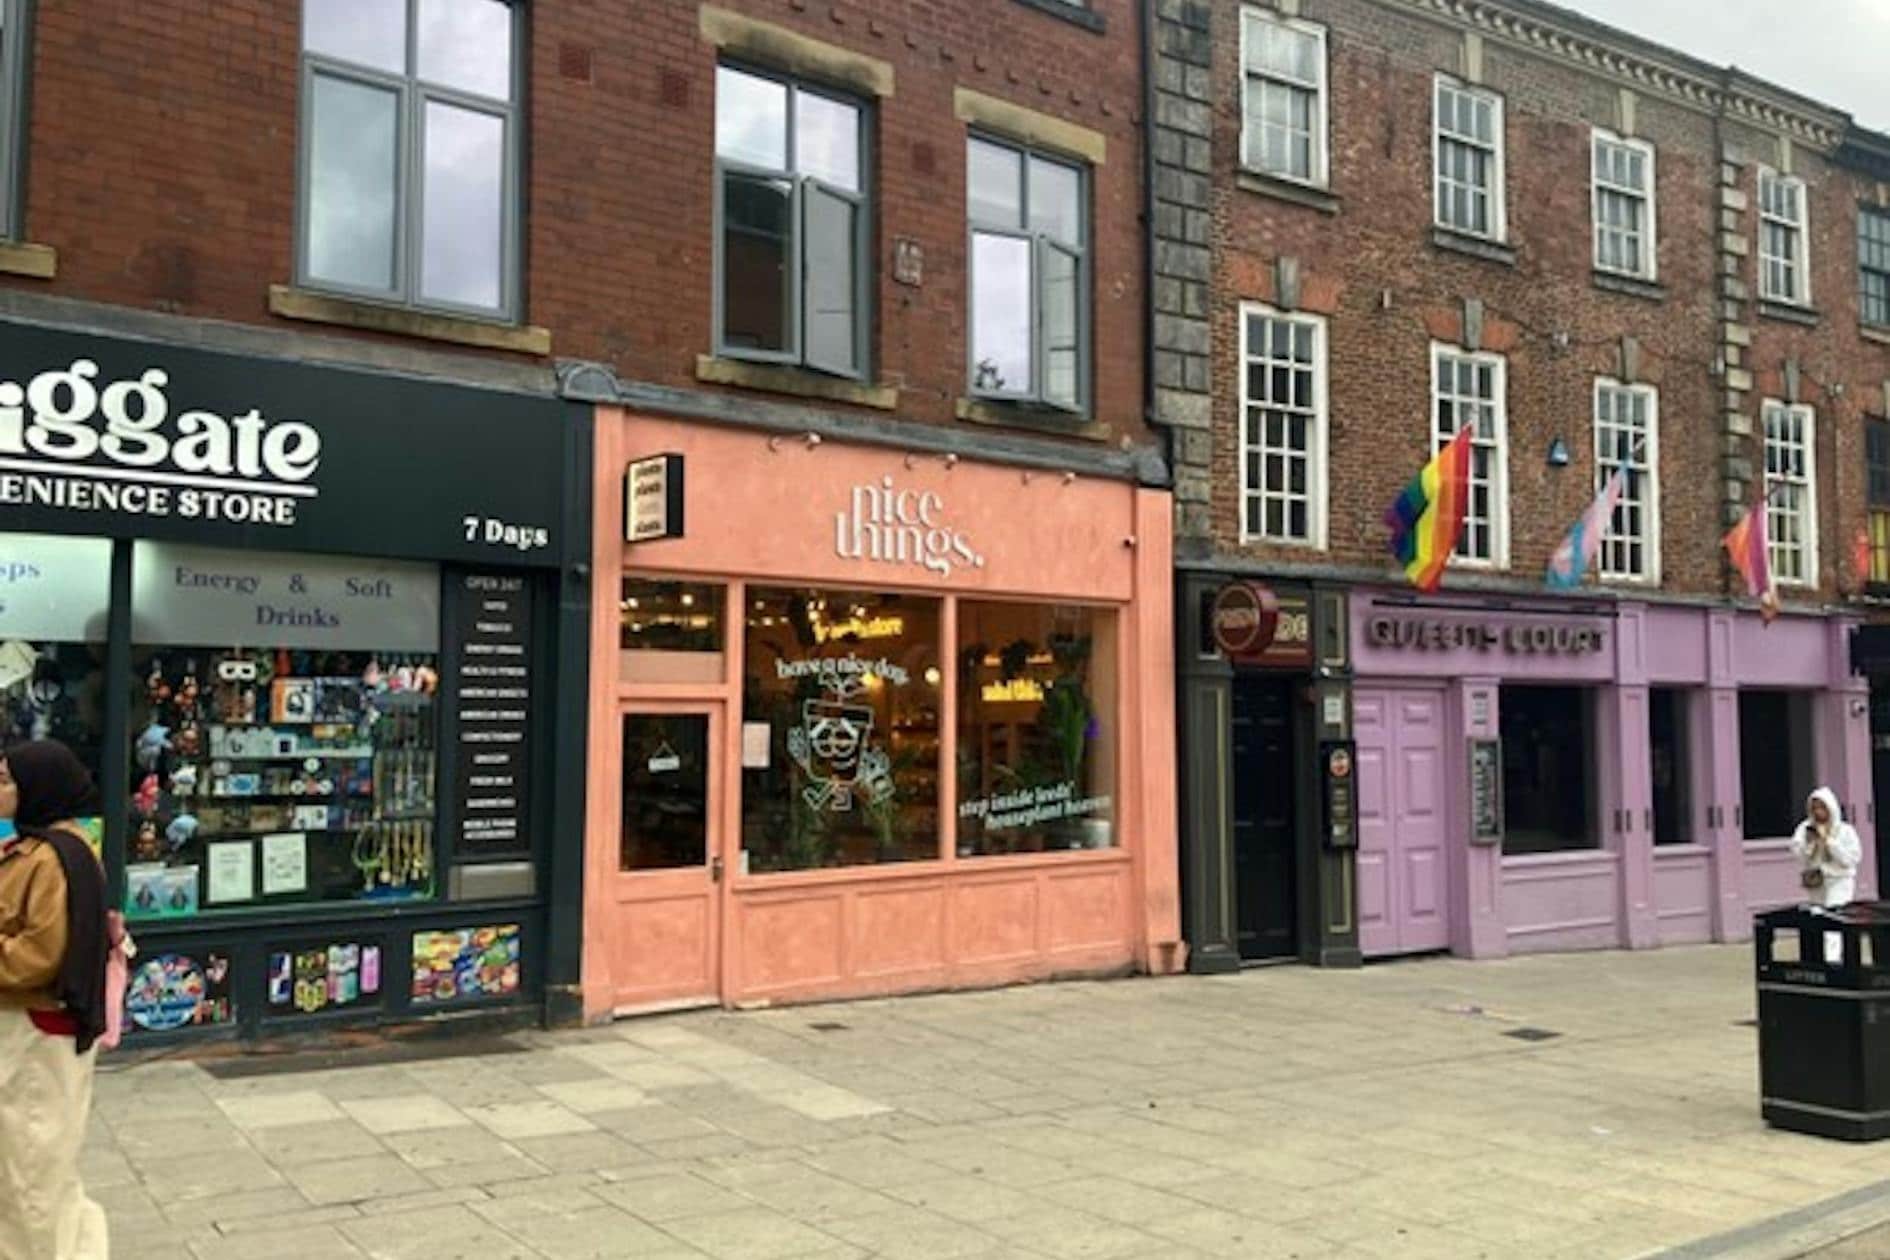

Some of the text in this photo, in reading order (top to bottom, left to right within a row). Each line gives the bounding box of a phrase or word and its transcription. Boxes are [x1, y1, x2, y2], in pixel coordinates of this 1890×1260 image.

[178, 488, 296, 524] STORE
[852, 475, 943, 527] nice
[463, 516, 548, 550] 7 Days
[835, 509, 984, 577] things.
[175, 565, 393, 598] Energy & Soft
[257, 604, 340, 628] Drinks
